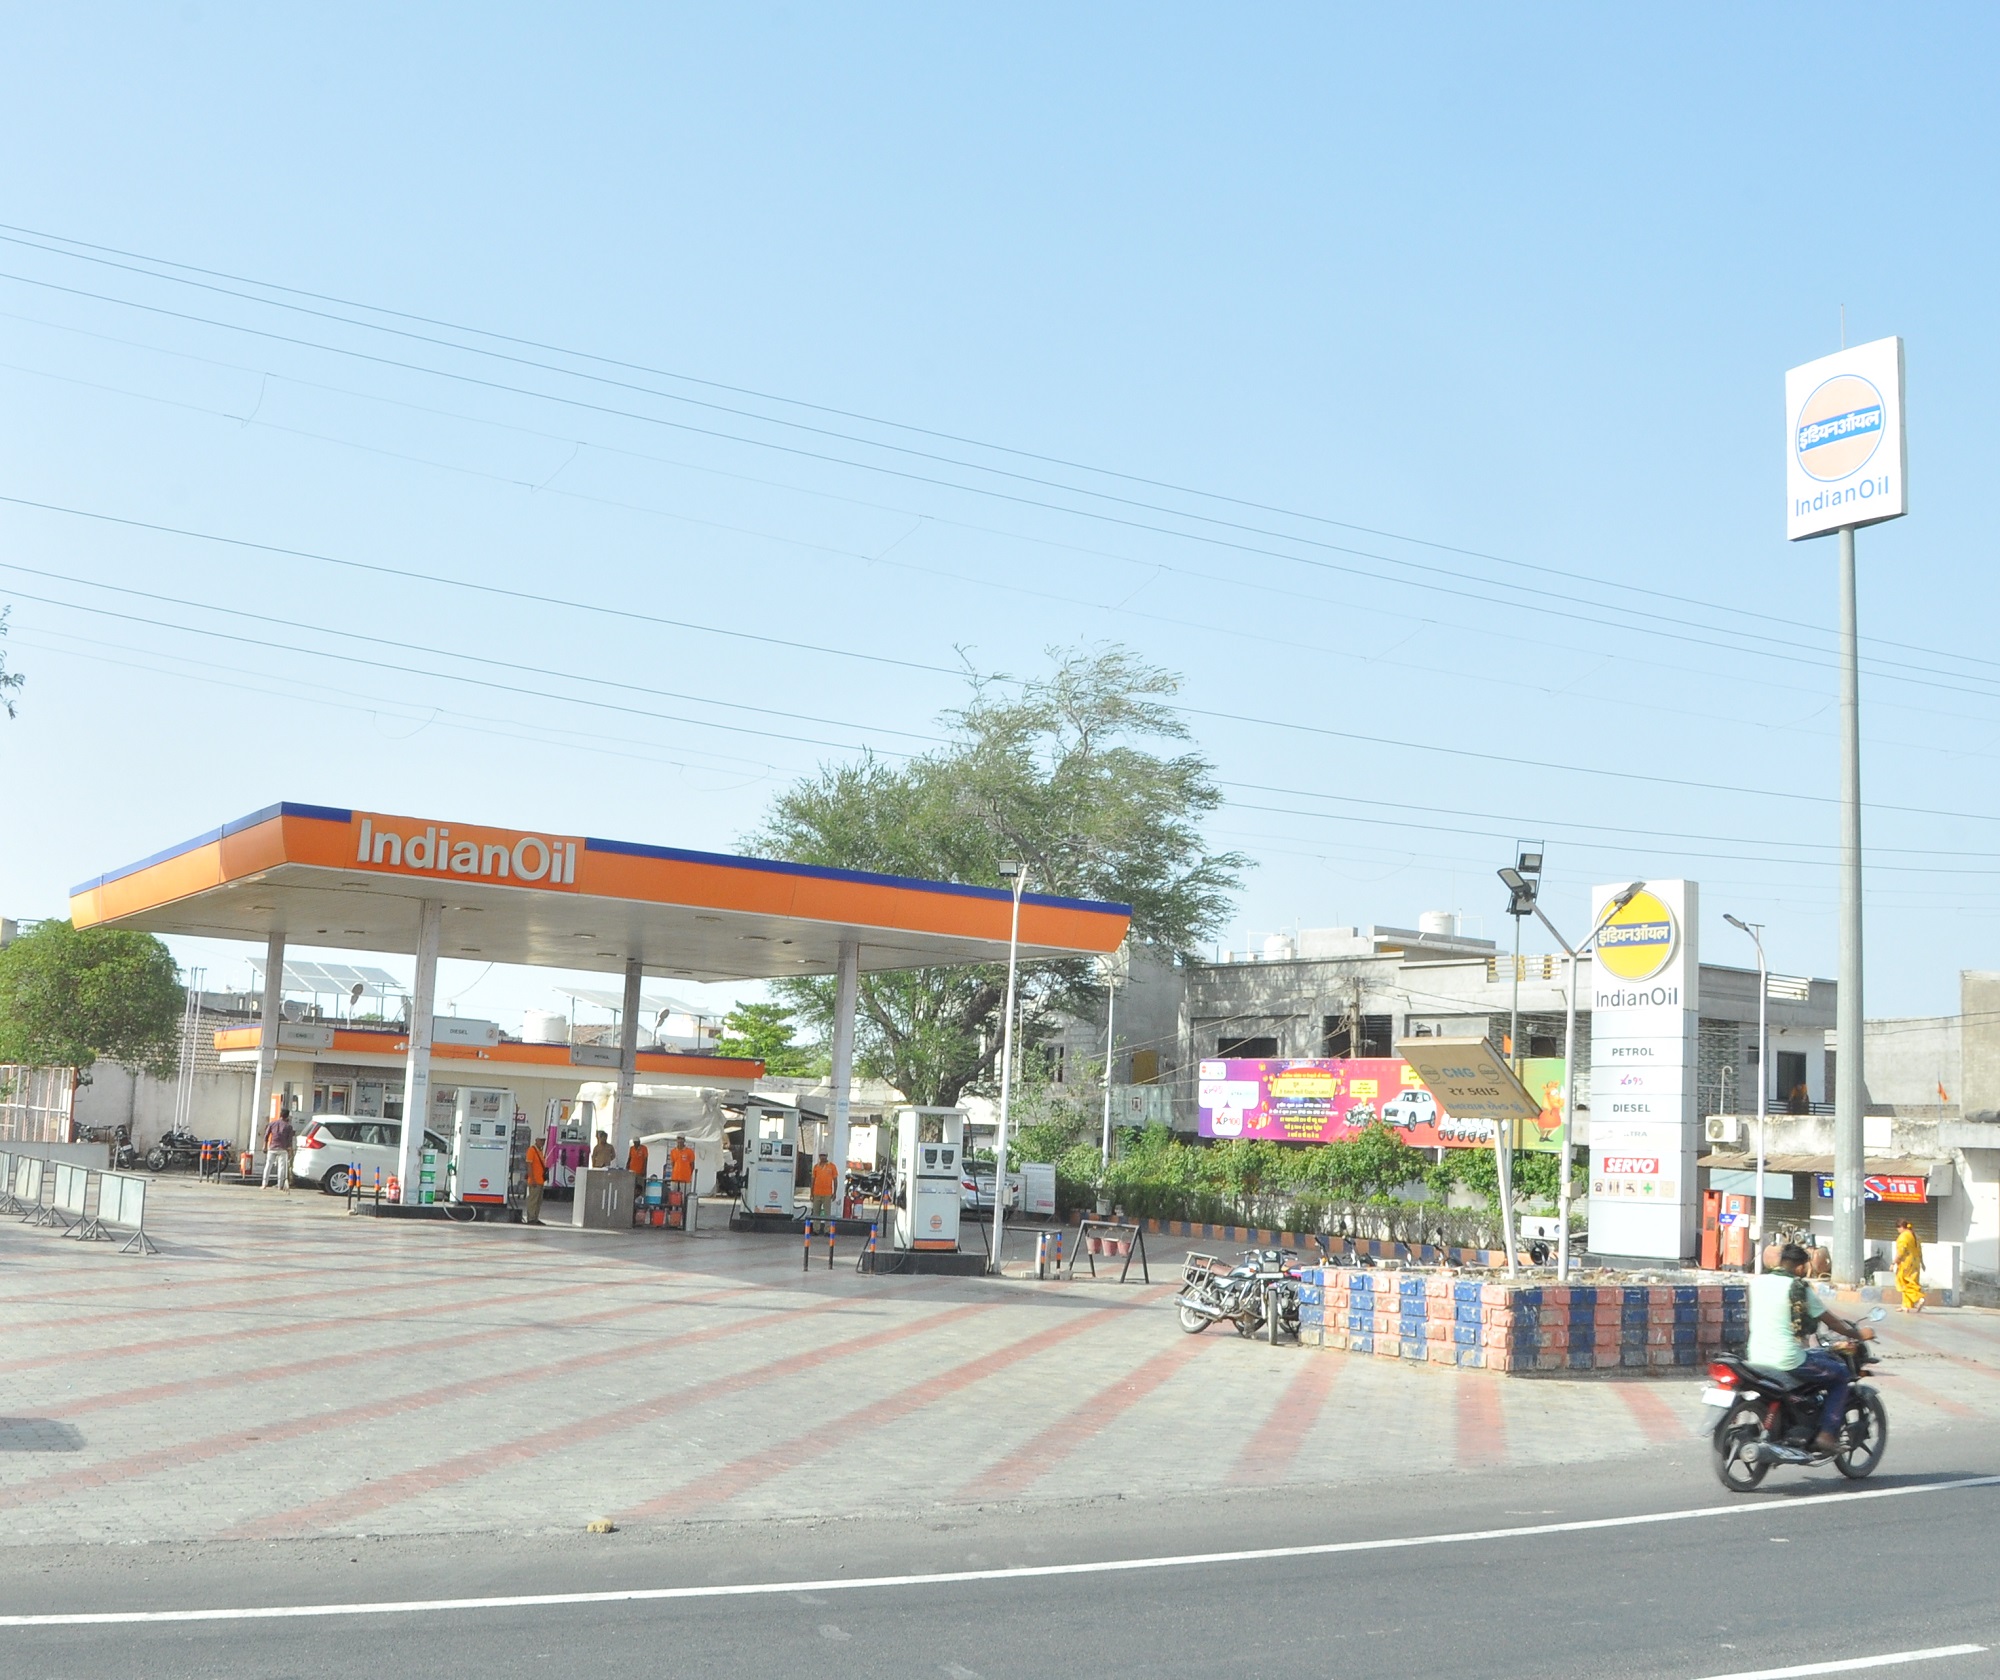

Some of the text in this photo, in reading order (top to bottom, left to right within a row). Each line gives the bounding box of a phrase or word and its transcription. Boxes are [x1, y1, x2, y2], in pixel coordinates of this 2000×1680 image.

[1799, 410, 1880, 449] इंडियनऑयल
[1795, 475, 1889, 516] IndianOil
[356, 818, 577, 884] IndianOil
[1596, 987, 1678, 1008] IndianOil
[449, 1028, 468, 1036] DIESEL
[1611, 1047, 1655, 1057] PETROL
[1442, 1066, 1476, 1079] CNG
[1612, 1103, 1651, 1113] DIESEL
[1606, 1157, 1655, 1173] SERVO
